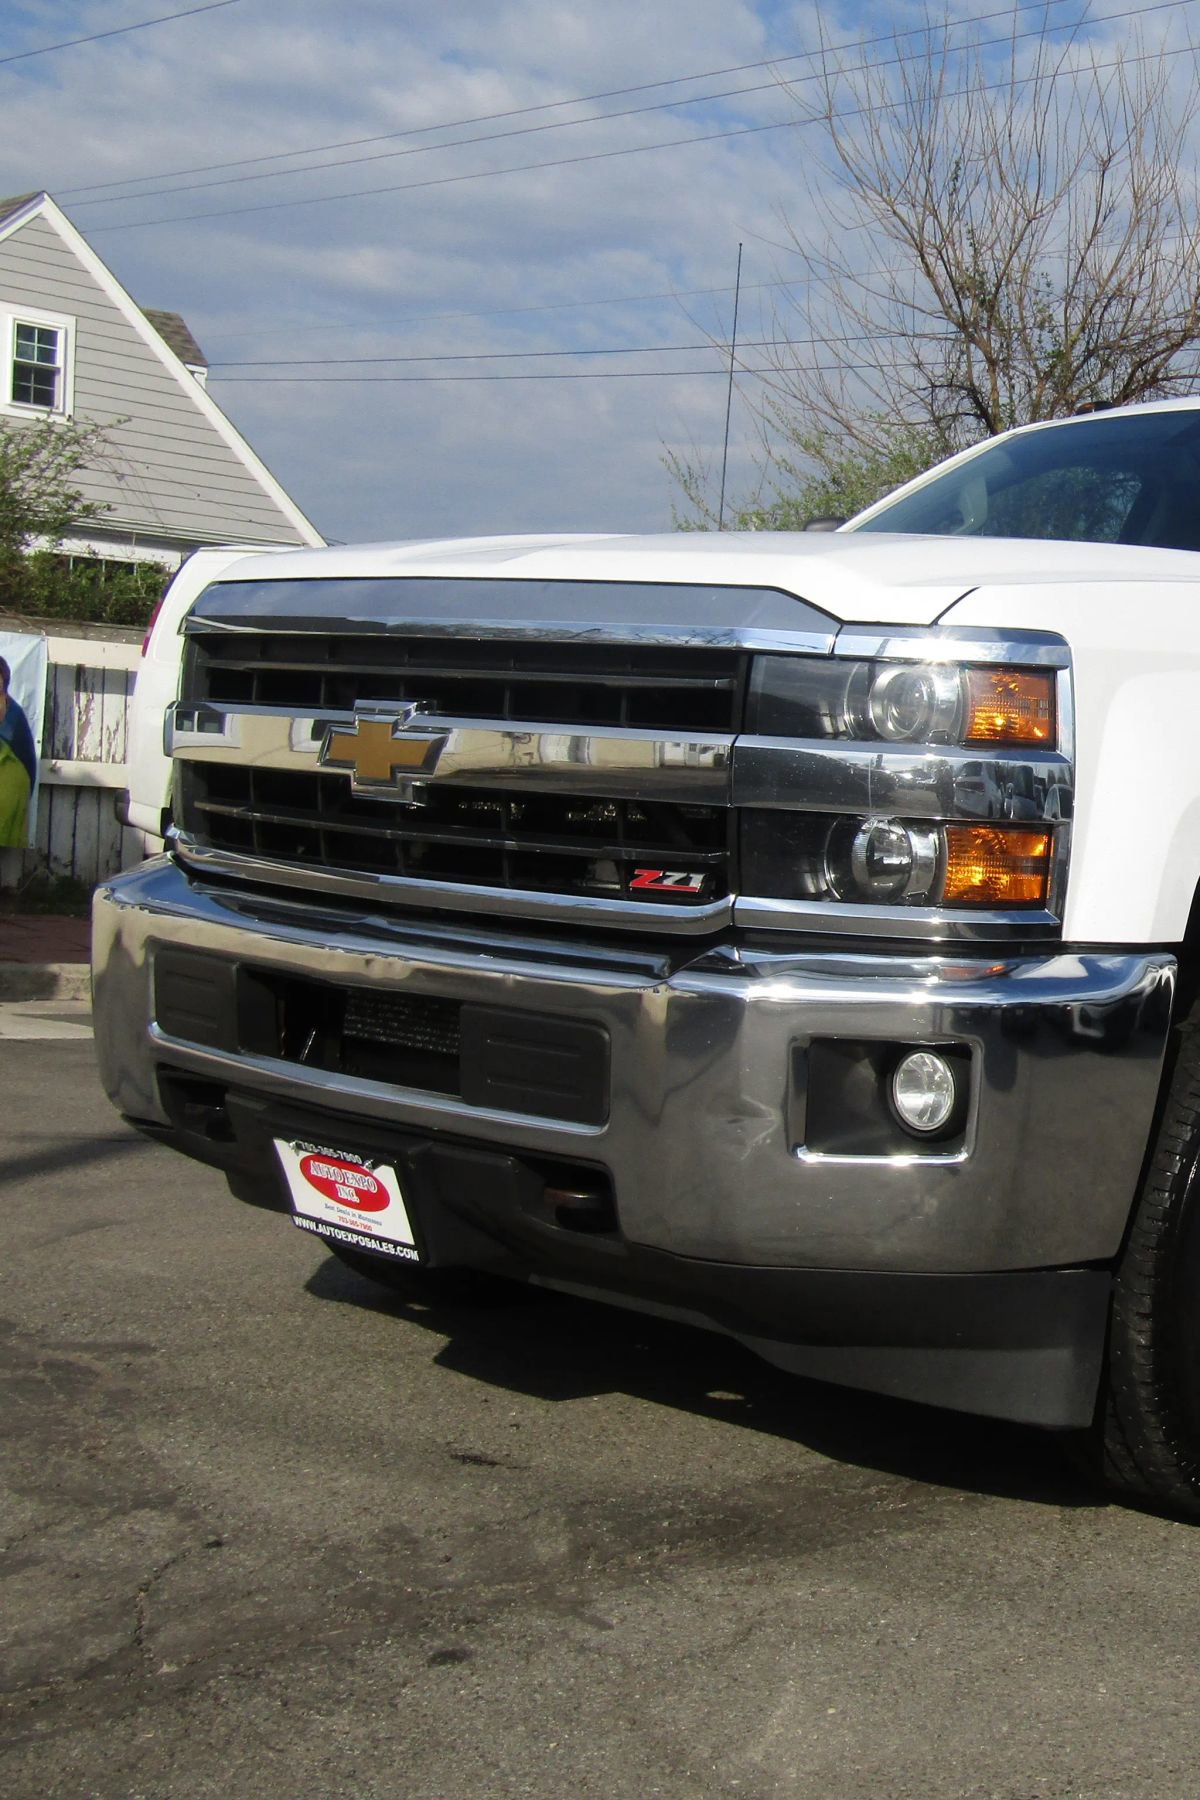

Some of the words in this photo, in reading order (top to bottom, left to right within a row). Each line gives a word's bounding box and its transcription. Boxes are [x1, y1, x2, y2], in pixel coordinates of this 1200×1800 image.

[629, 868, 706, 893] Z71
[310, 1160, 344, 1183] AUTO
[341, 1169, 378, 1193] EXPO
[293, 1215, 420, 1262] WWW.AUTOEXPOSALES.COM
